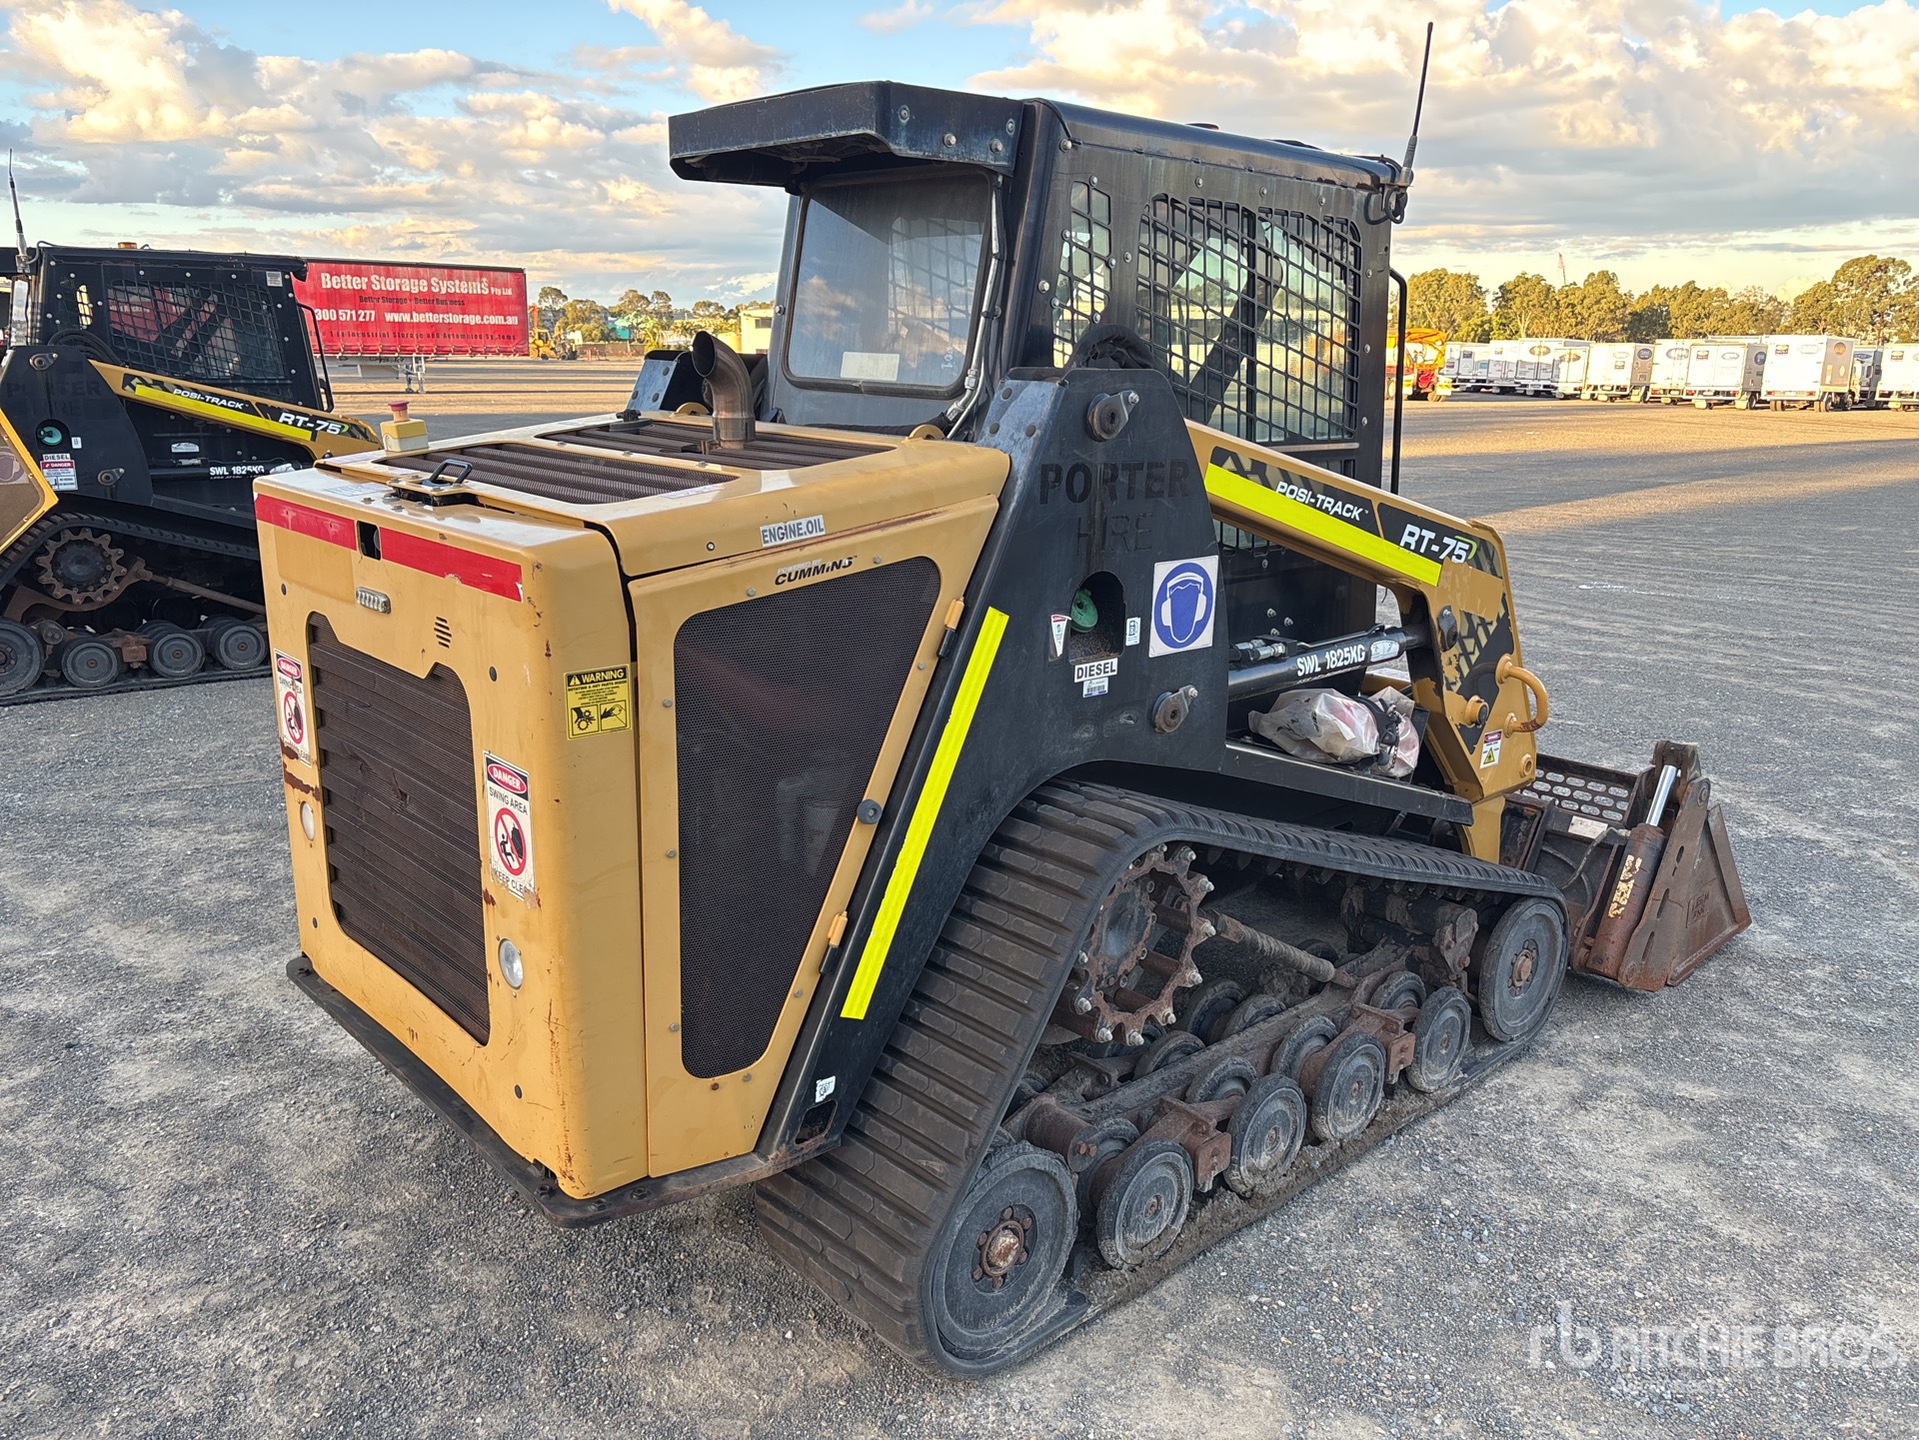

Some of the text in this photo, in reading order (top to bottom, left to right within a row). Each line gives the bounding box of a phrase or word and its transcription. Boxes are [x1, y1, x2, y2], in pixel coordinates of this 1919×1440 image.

[321, 272, 368, 290] Better
[370, 274, 428, 294] Storage
[359, 295, 465, 307] Better Storage Better Business
[314, 308, 519, 326] 300 571 277 www.betterstorage.com.au
[172, 388, 245, 410] POSI-TRACK
[278, 412, 344, 436] RT-75
[209, 466, 229, 476] SWL
[1038, 458, 1192, 506] PORTER
[1275, 481, 1364, 522] POSI-TRACK
[1399, 523, 1473, 565] RT-75
[1076, 661, 1117, 680] DIESEL
[1296, 654, 1322, 677] SWL
[1324, 643, 1366, 670] 1825KG
[581, 669, 625, 683] WARNING
[492, 767, 522, 791] DANGER
[489, 786, 528, 815] SWING AREA
